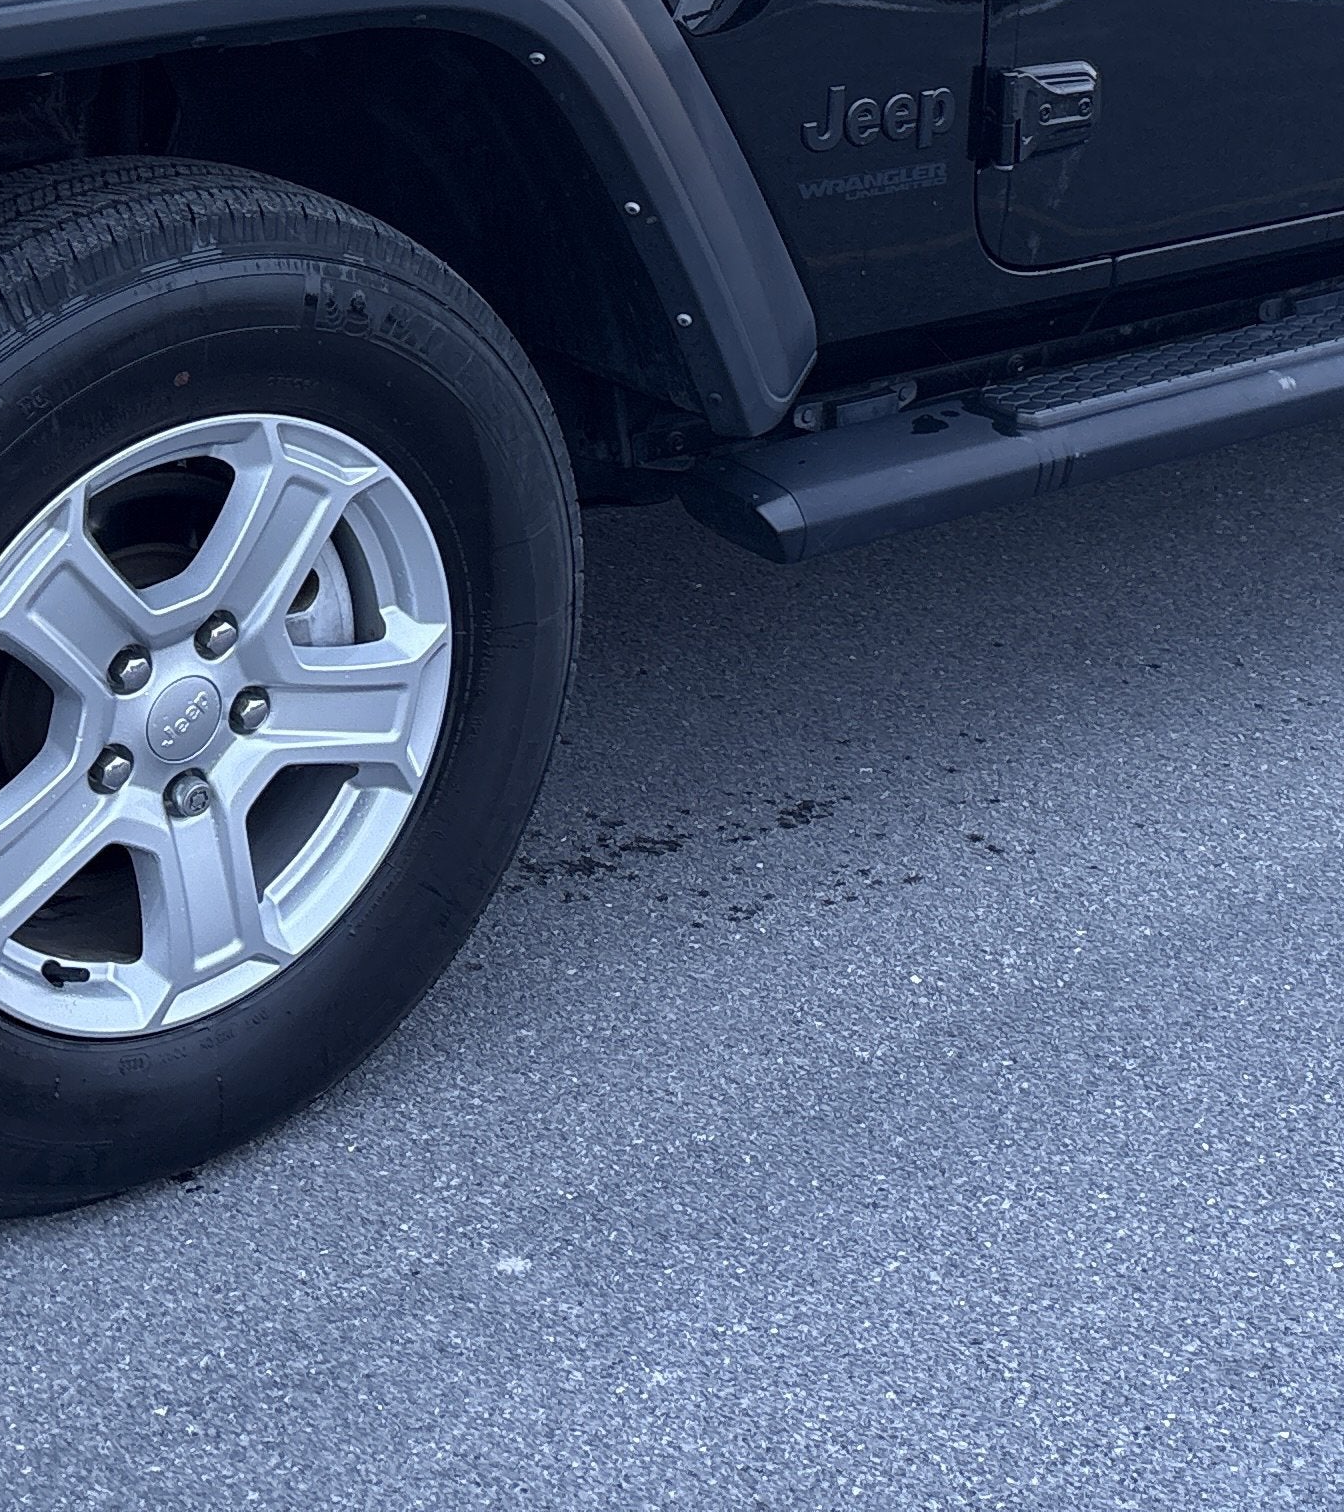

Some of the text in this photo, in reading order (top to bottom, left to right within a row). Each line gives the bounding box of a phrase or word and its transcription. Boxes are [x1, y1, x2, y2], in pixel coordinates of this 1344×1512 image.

[800, 84, 957, 153] Jeep
[798, 162, 947, 200] WRANGLER
[160, 689, 210, 749] Jeep
